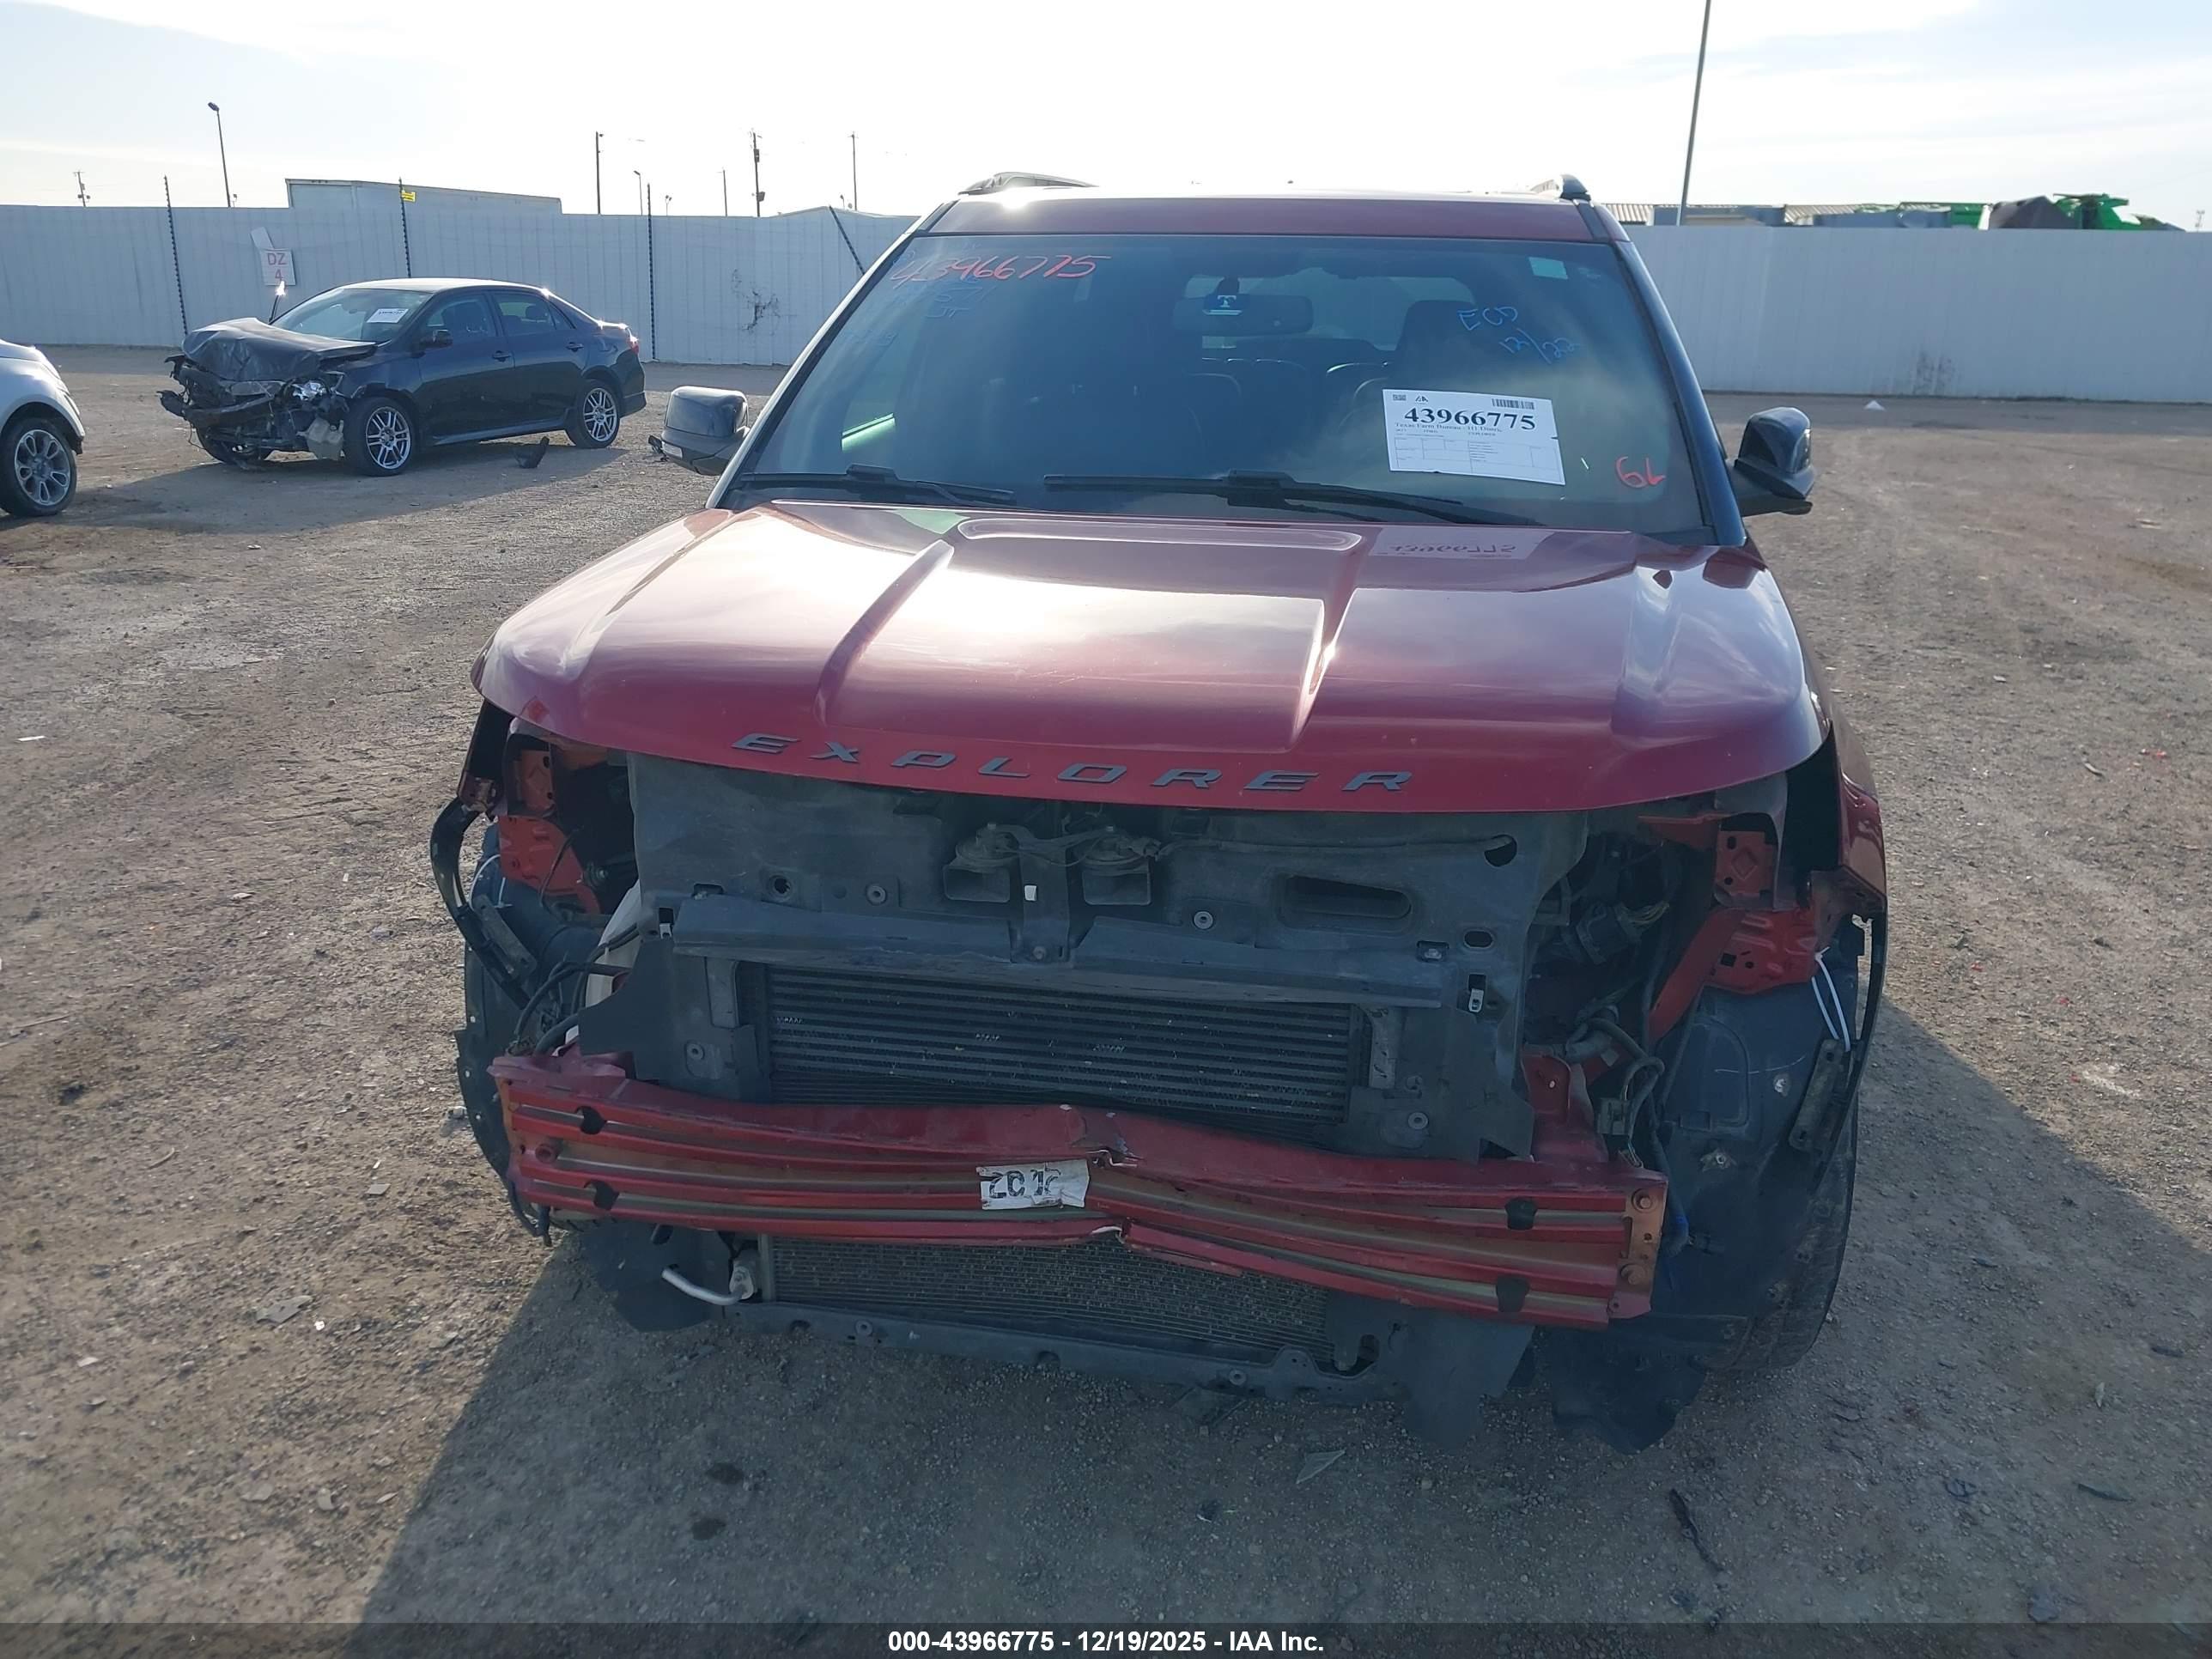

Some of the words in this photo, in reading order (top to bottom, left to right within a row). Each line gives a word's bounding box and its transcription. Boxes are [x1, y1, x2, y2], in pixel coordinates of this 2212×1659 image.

[267, 252, 287, 265] DZ
[275, 269, 283, 281] 4
[890, 255, 1111, 289] 43966775
[1405, 407, 1535, 430] 43966775
[732, 732, 1413, 792] EXPLORER
